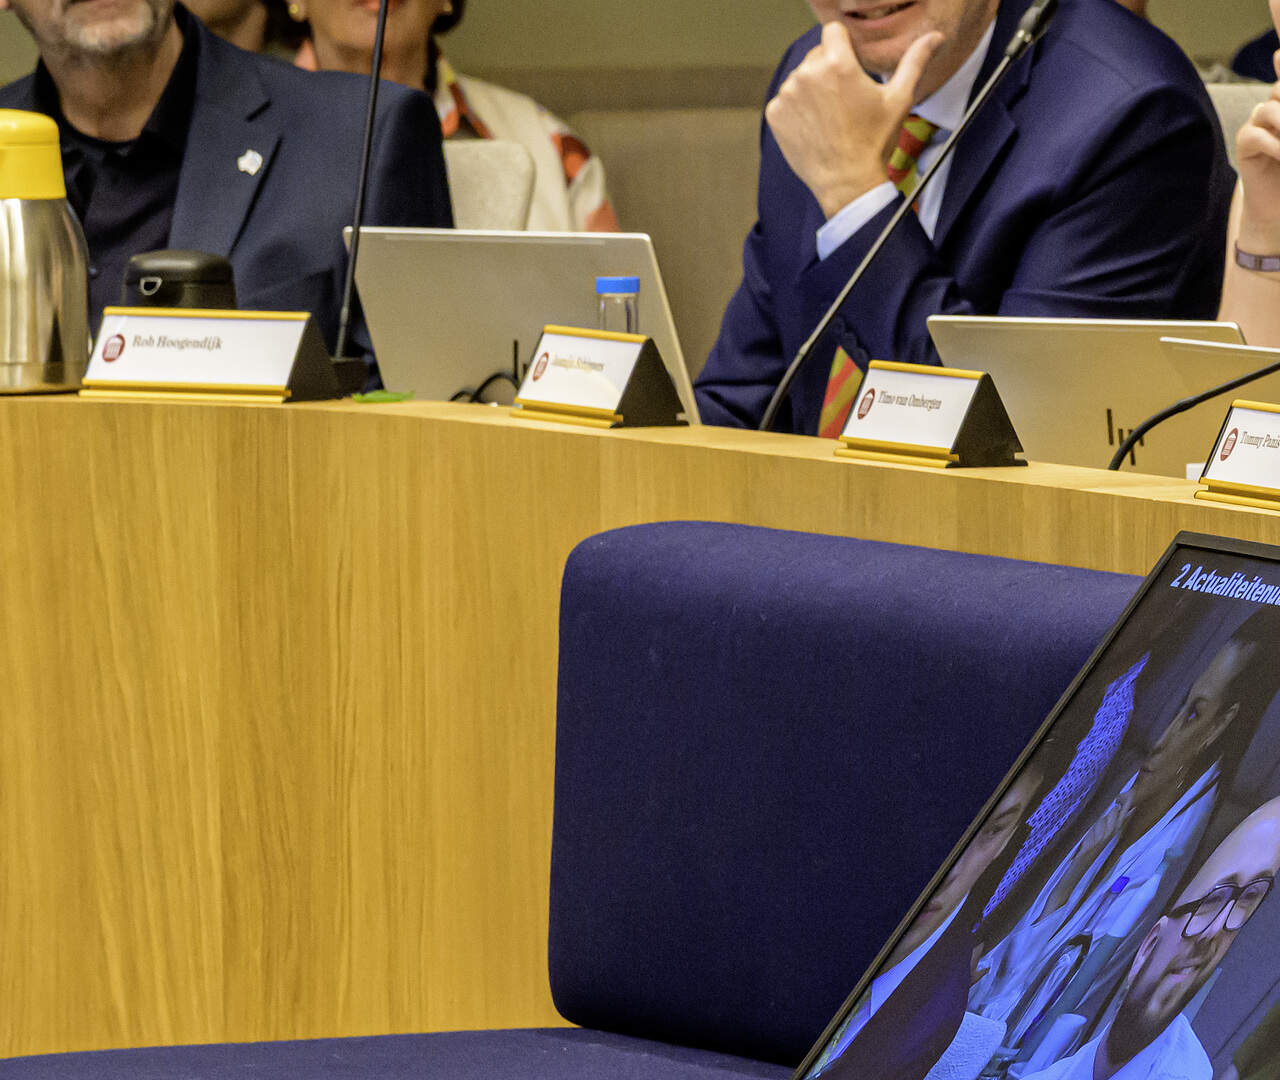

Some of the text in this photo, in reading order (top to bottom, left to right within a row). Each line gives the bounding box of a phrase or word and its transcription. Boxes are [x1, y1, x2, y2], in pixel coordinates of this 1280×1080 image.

[132, 334, 223, 351] Rob Hoogendijk
[1240, 431, 1265, 448] Tommy
[1170, 562, 1192, 588] 2
